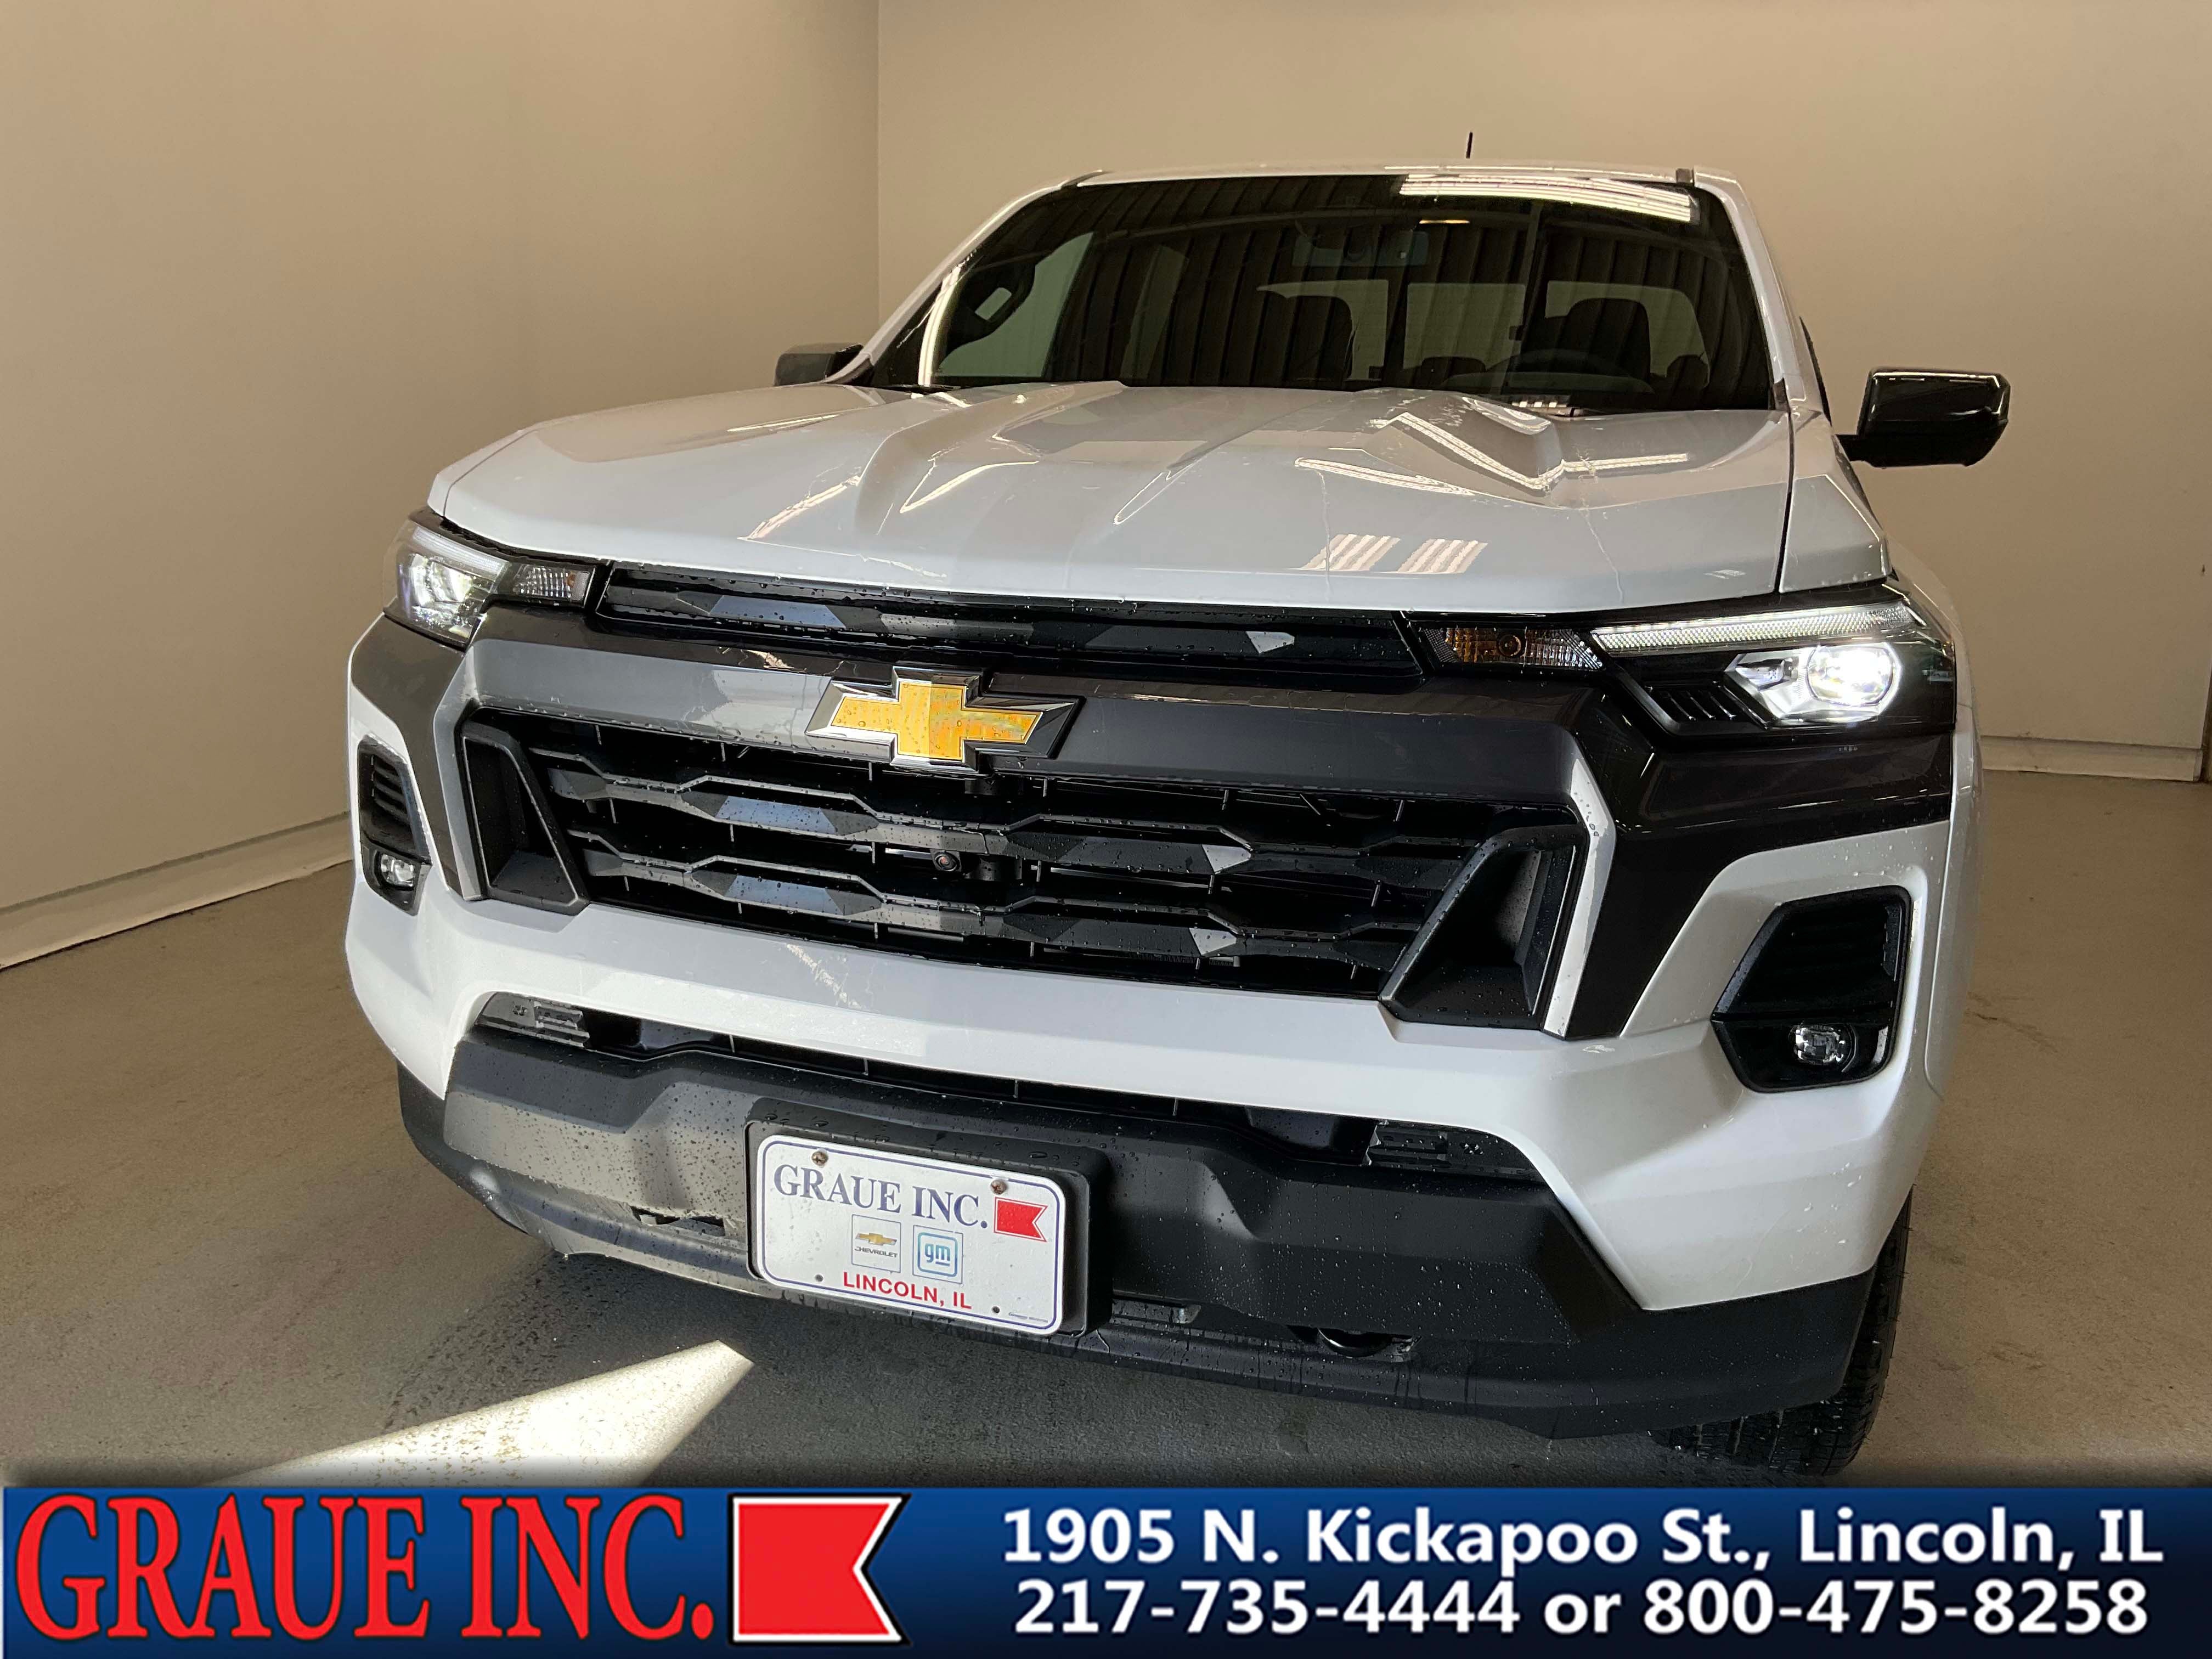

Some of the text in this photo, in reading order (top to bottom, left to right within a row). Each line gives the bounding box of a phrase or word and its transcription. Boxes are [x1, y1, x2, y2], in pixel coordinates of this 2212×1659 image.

[774, 1164, 988, 1229] GRAUE INC.
[854, 1246, 898, 1258] CHEVROLET
[924, 1243, 951, 1265] gm
[843, 1271, 972, 1310] LINCOLN, IL
